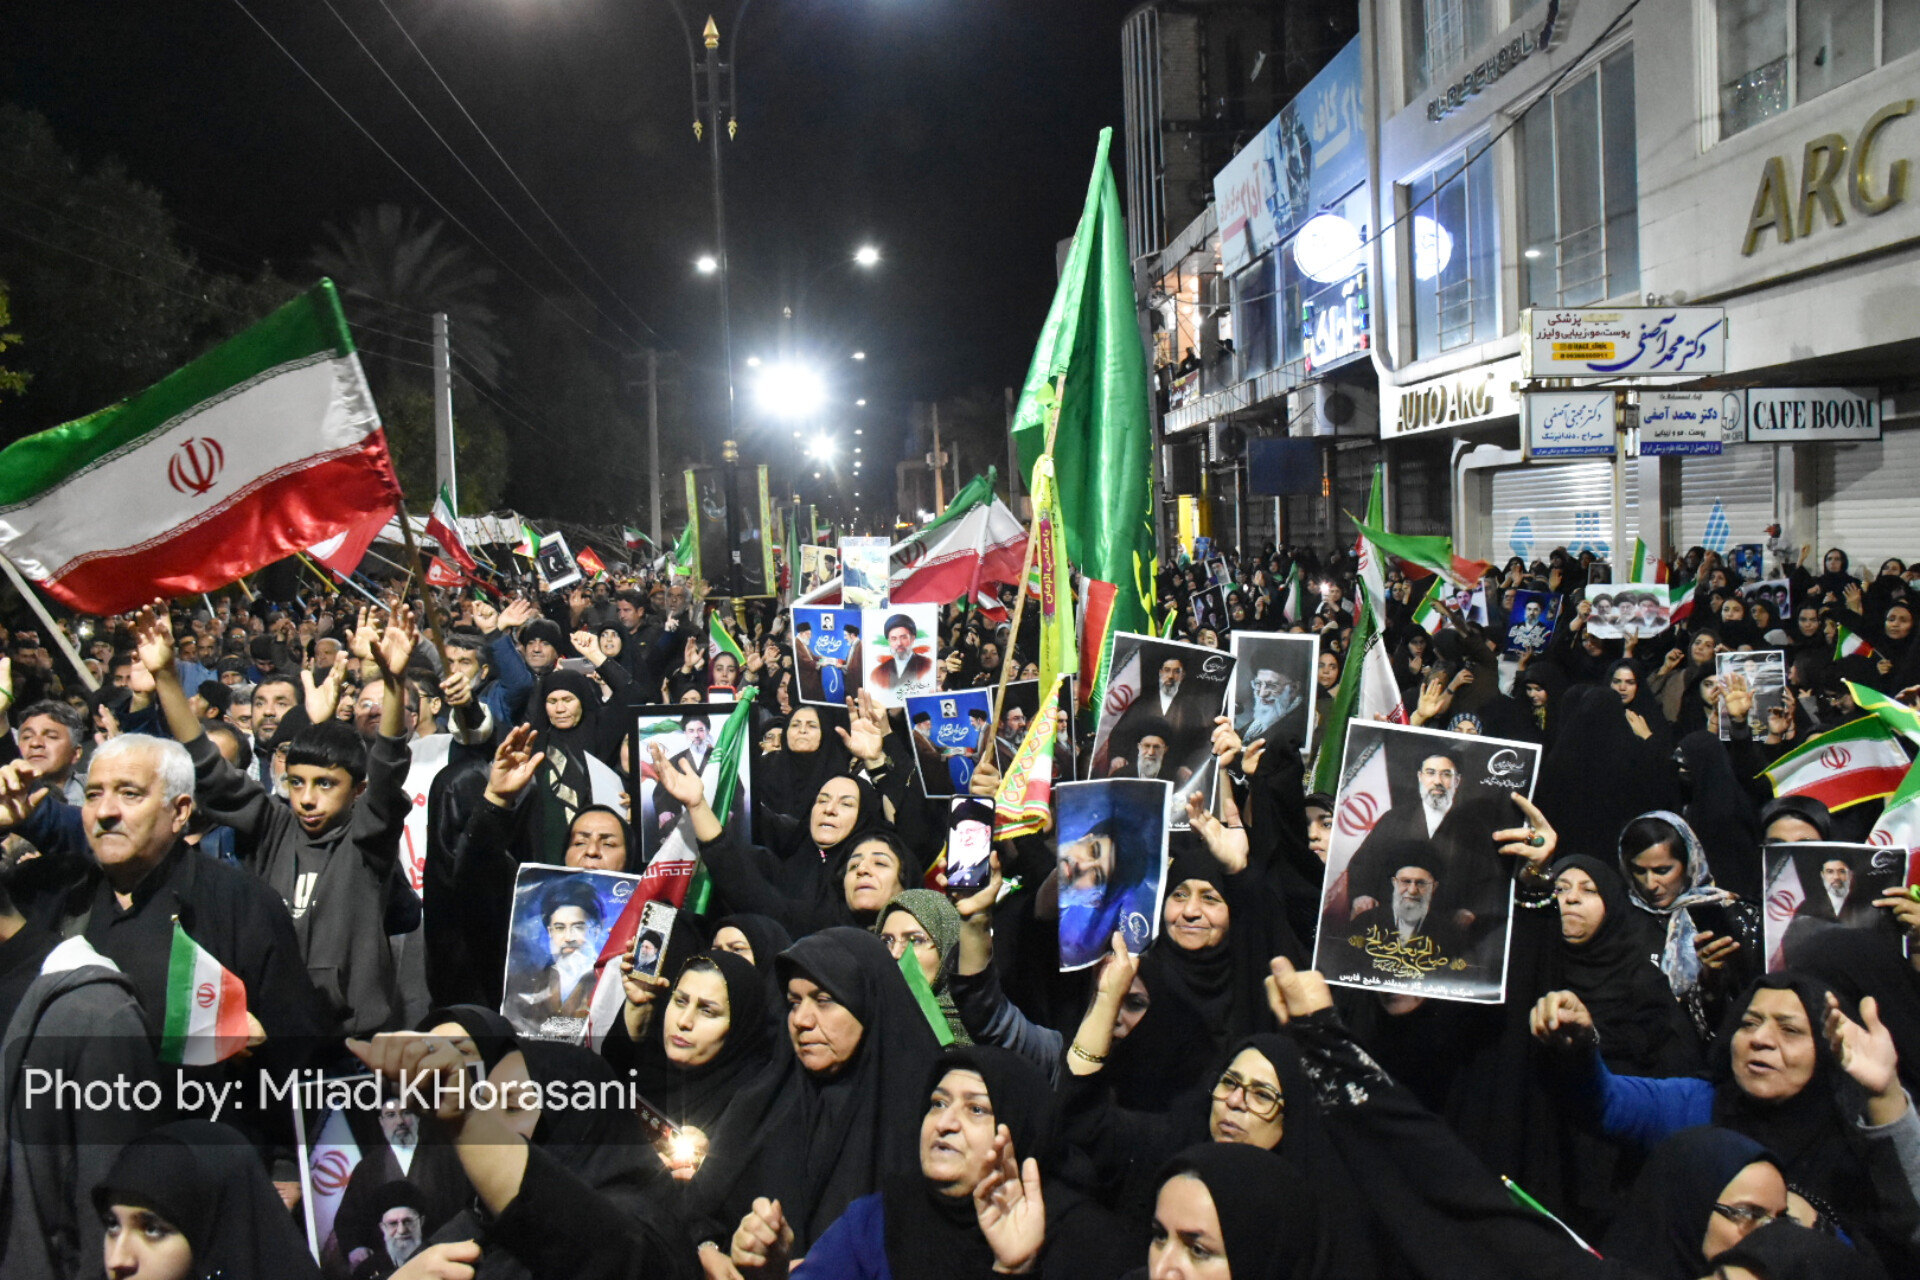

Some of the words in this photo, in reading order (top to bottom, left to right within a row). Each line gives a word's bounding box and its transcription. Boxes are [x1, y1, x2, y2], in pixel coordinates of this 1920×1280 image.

[1741, 98, 1916, 258] ARG
[1547, 313, 1582, 328] پزشکی
[1586, 313, 1677, 373] آصفی
[1649, 334, 1685, 370] محمد
[1674, 318, 1723, 372] دکتر
[1396, 384, 1448, 433] AUTO
[1448, 371, 1495, 422] ARG
[1543, 402, 1572, 429] آصفی
[1580, 395, 1609, 429] دکتر
[1643, 406, 1670, 425] آصفی
[1672, 410, 1697, 420] محمد
[1699, 408, 1718, 425] دکتر
[1753, 401, 1806, 430] CAFE
[1811, 400, 1873, 429] BOOM
[1339, 972, 1361, 982] فارس
[1362, 976, 1381, 985] خلیج
[1411, 981, 1422, 991] گاز
[1423, 984, 1448, 996] پالایش
[1450, 988, 1474, 998] شرکت
